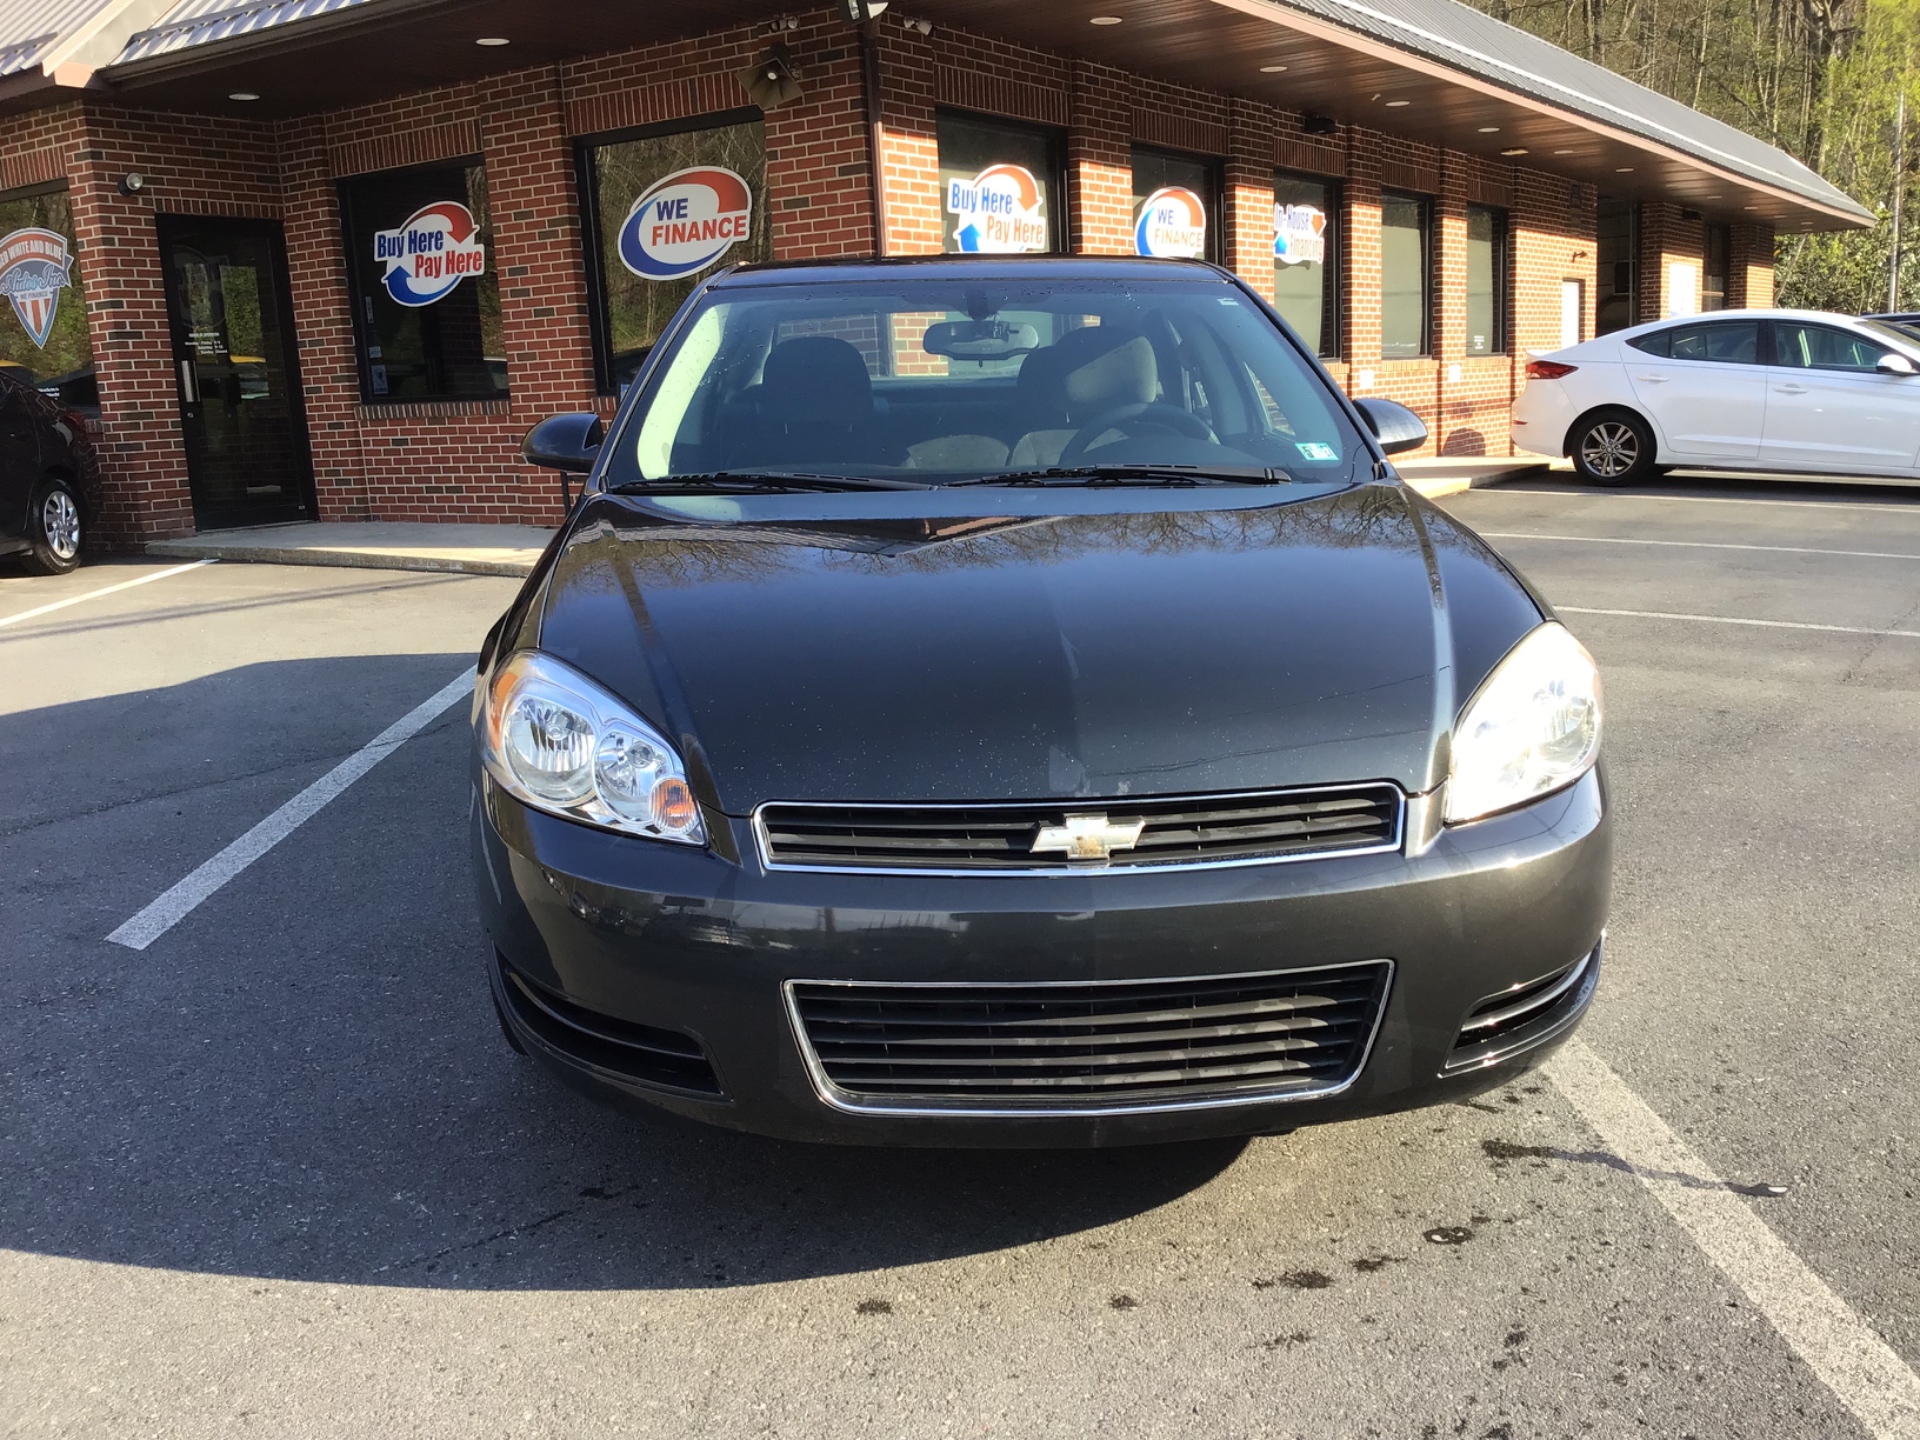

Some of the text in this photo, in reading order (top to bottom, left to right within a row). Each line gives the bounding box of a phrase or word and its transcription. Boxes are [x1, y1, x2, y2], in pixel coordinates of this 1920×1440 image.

[656, 198, 688, 221] WE
[952, 183, 1013, 214] Buy Here
[652, 215, 747, 246] FINANCE
[987, 215, 1043, 244] Pay Here
[1158, 208, 1174, 225] WE
[8, 241, 30, 261] WHITE
[30, 240, 44, 253] AND
[45, 241, 62, 260] BLUE
[377, 229, 444, 258] Buy Here
[1154, 228, 1203, 247] FINANCE
[415, 250, 482, 279] Pay Here
